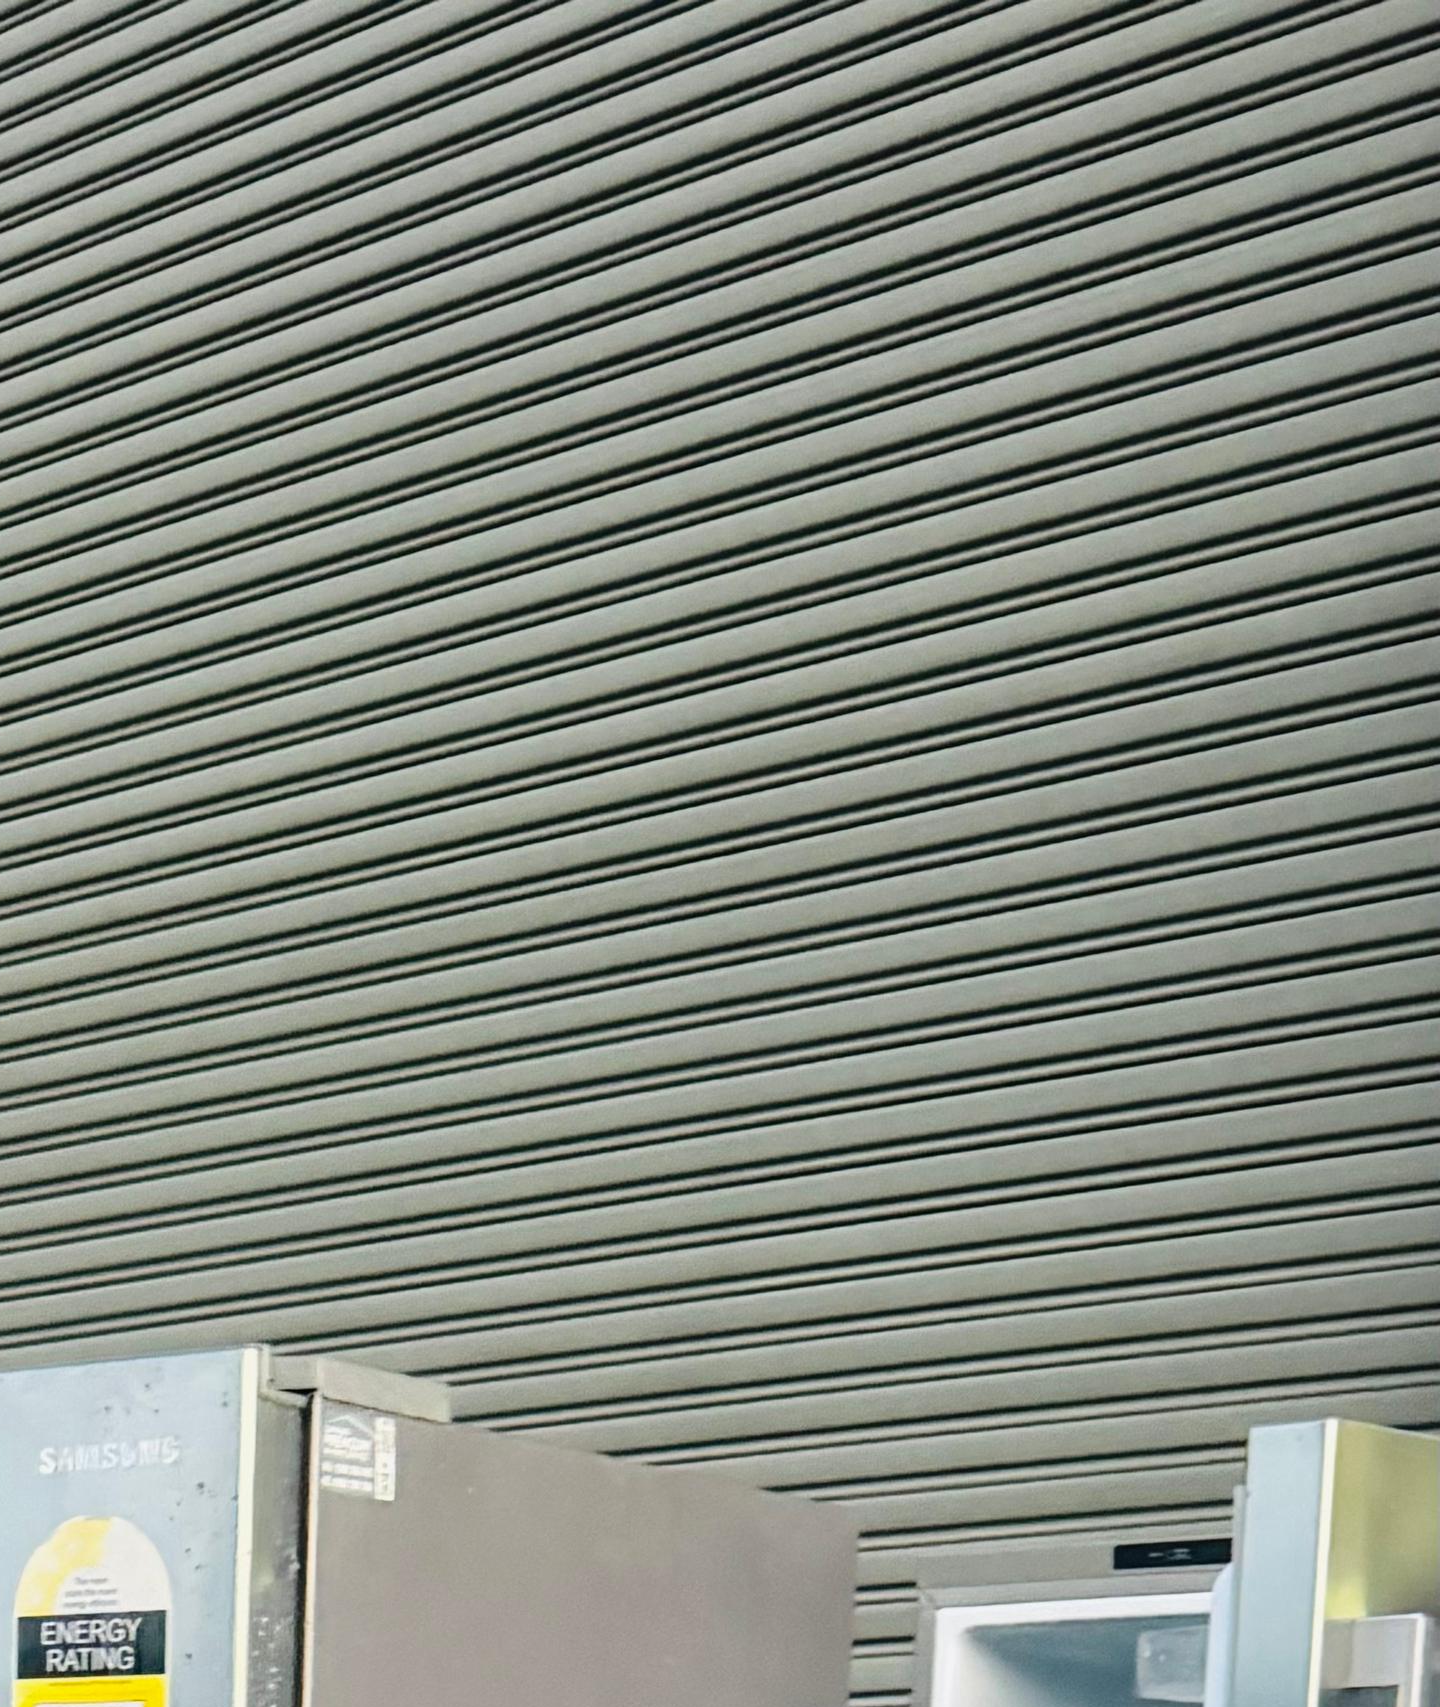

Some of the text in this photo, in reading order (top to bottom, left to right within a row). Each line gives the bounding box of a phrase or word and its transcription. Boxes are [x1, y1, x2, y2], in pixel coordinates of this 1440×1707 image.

[39, 1435, 181, 1475] SAMSUNG
[40, 1616, 143, 1645] ENERGY
[45, 1645, 136, 1673] RATING
